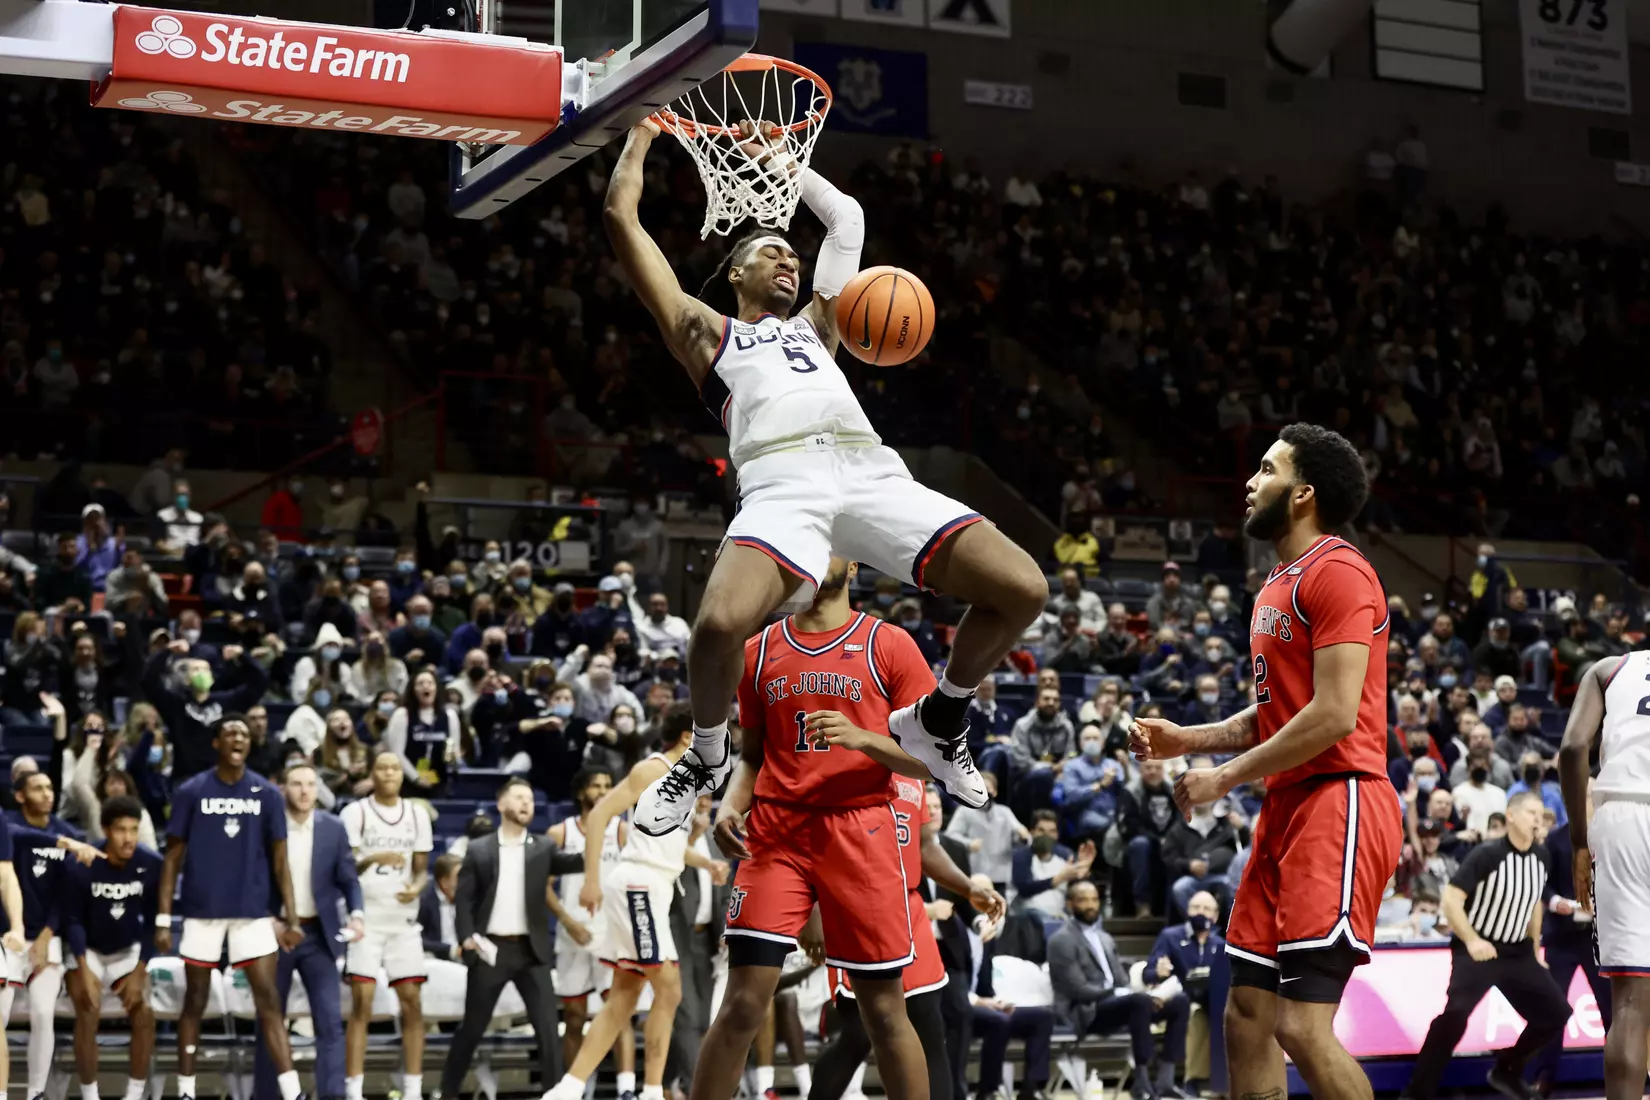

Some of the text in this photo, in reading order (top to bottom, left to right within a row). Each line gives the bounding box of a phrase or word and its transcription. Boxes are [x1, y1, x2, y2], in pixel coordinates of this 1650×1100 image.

[895, 315, 910, 349] UCONN
[781, 346, 819, 374] 5
[765, 671, 863, 706] ST. JOHN'S
[794, 710, 831, 753] 1
[201, 797, 262, 816] UCONN
[91, 880, 144, 900] UCONN
[632, 893, 654, 959] HUSKIES
